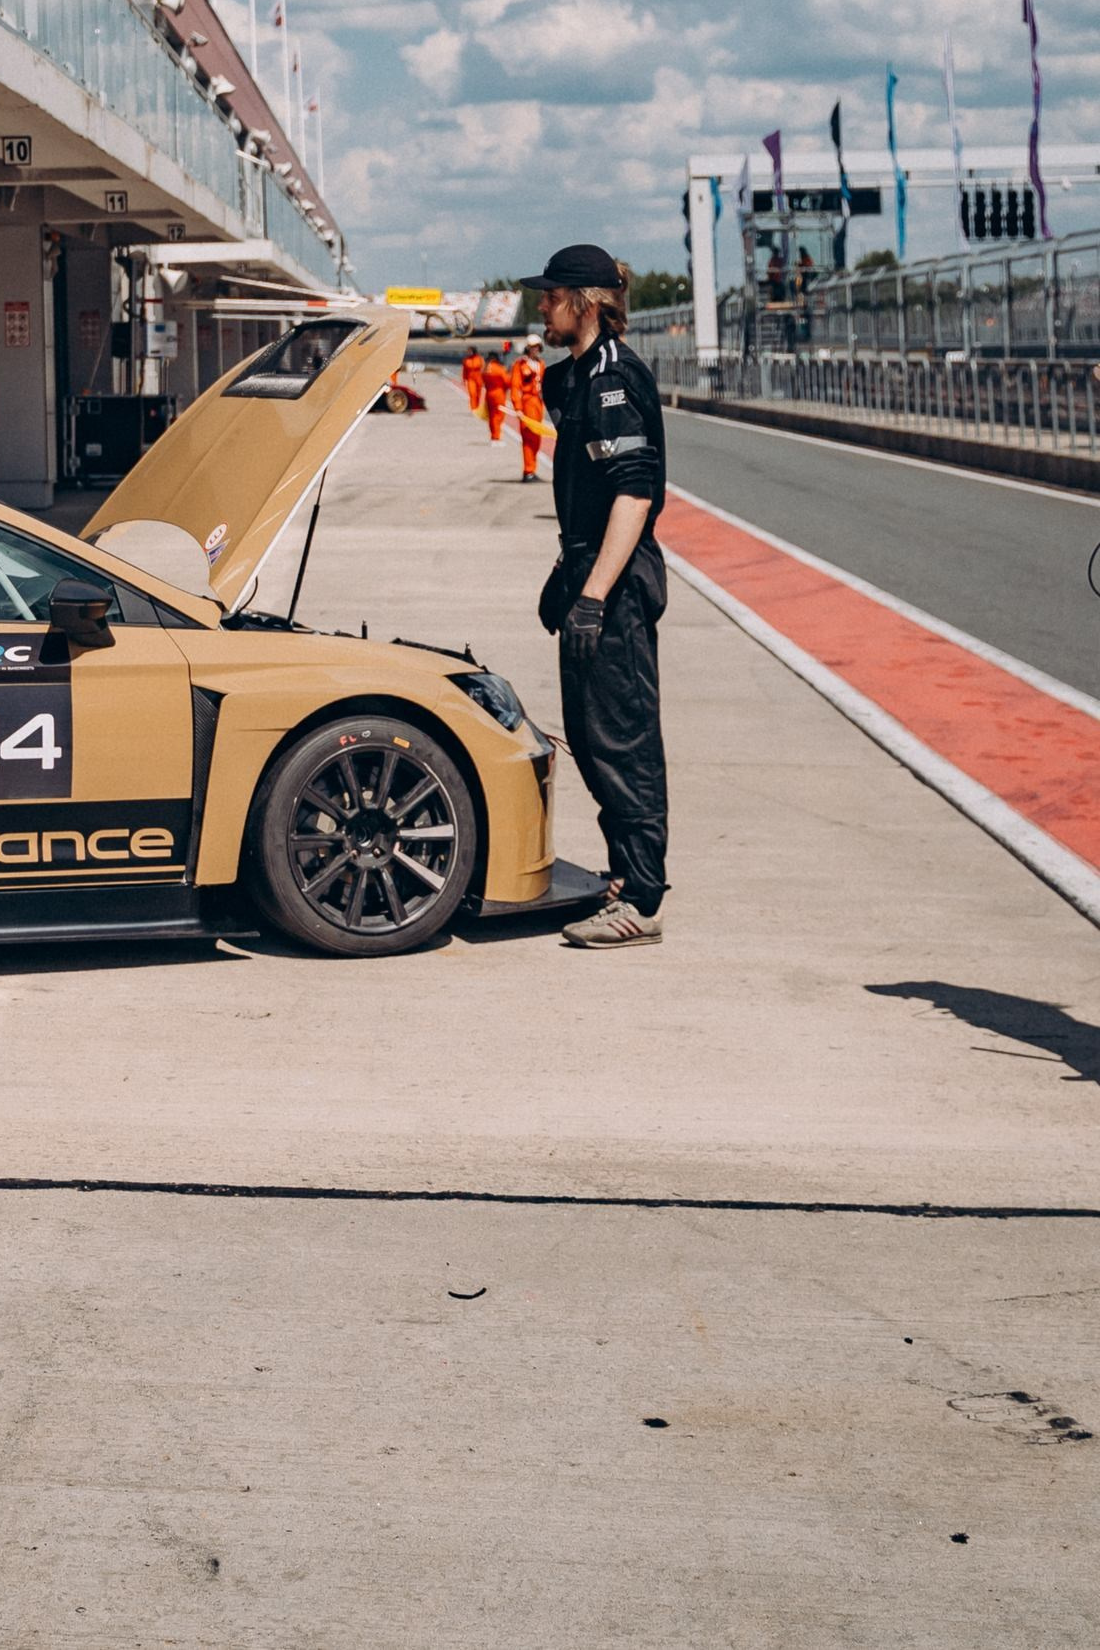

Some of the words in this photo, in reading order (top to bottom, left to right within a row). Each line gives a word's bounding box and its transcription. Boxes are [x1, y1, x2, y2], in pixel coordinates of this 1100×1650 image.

[5, 141, 28, 162] 10
[108, 194, 125, 211] 11
[602, 392, 625, 404] OMP
